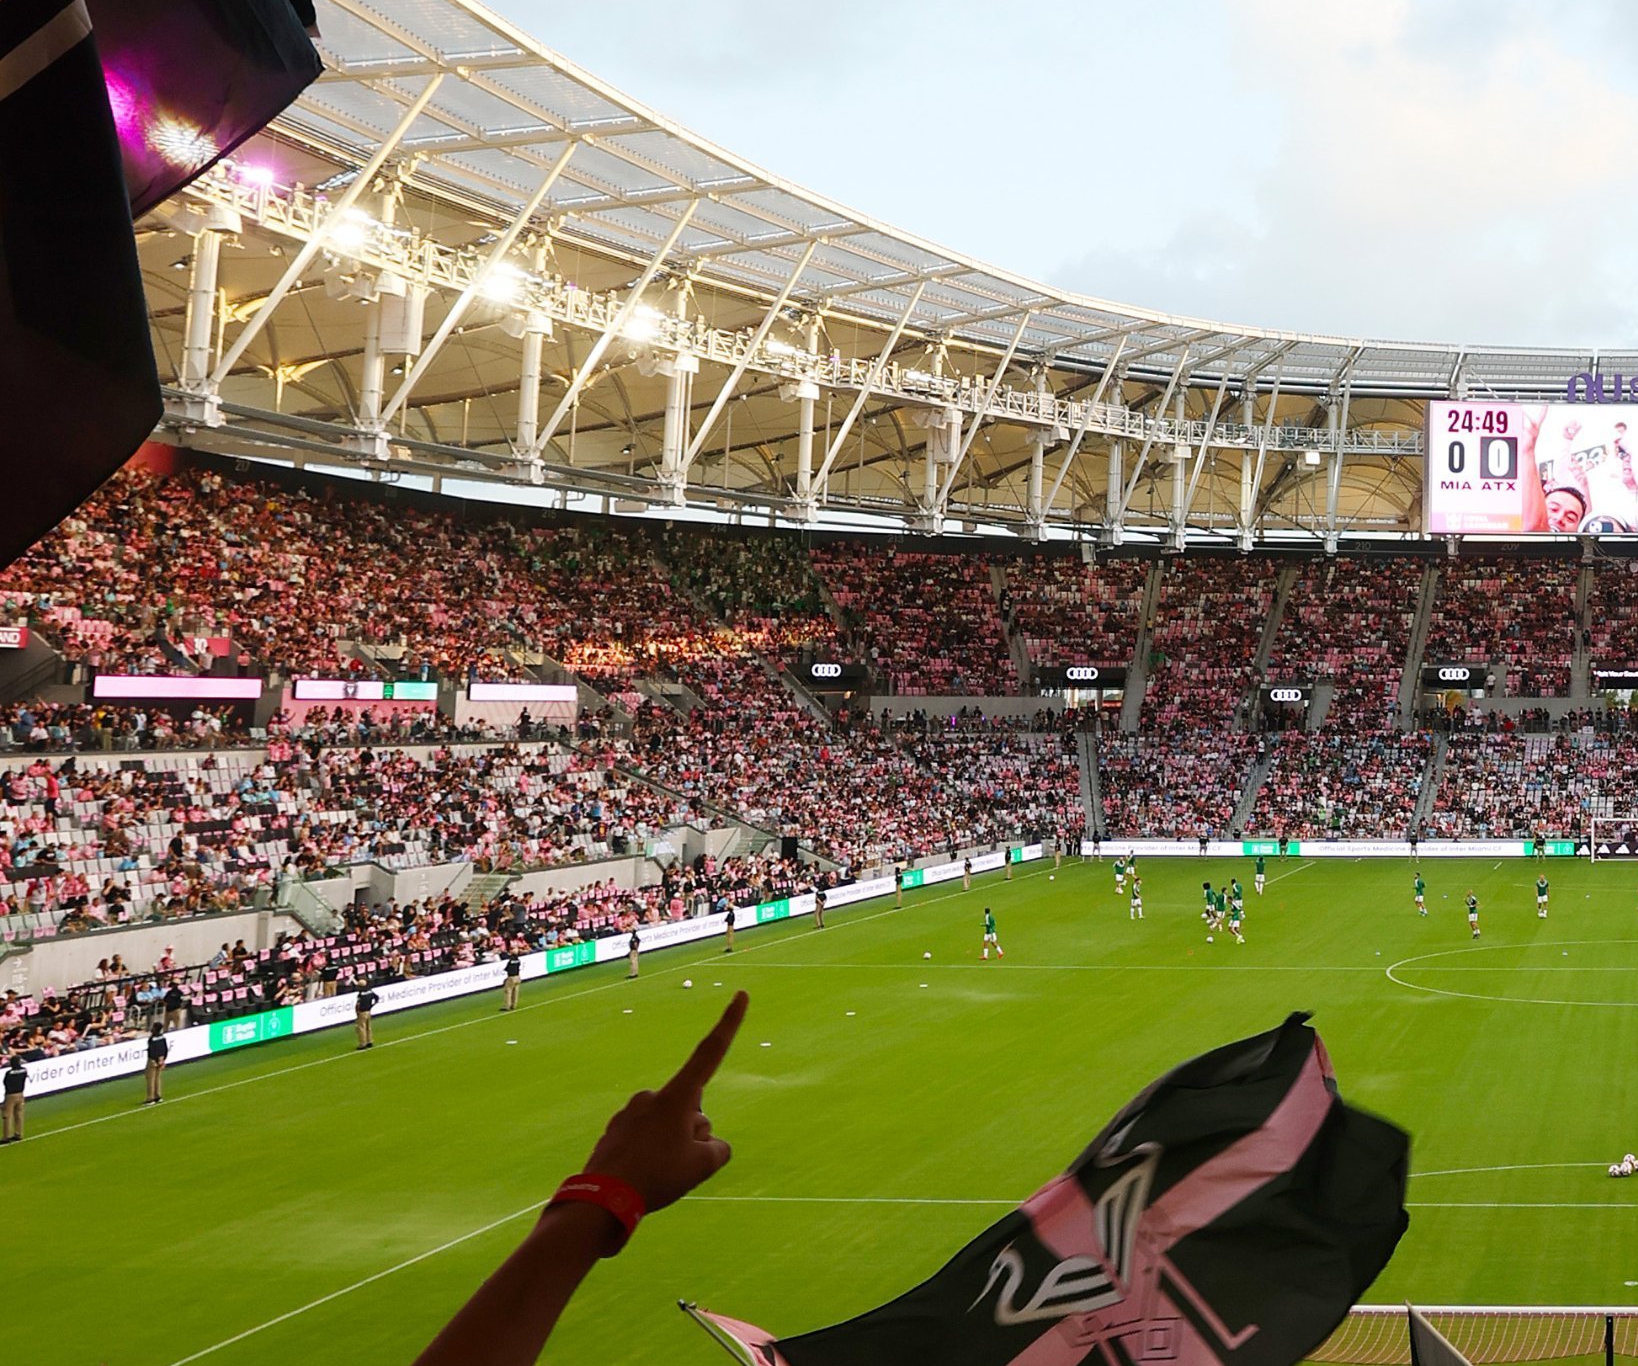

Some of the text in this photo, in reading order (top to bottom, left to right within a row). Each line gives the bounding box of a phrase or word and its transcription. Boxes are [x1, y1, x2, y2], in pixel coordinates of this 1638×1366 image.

[1447, 410, 1508, 434] 24:49
[1448, 440, 1465, 474] 0
[1488, 439, 1510, 477] 0
[1440, 481, 1472, 490] MIA
[1481, 481, 1516, 491] ATX
[320, 968, 506, 1017] Official Medicine Provider of Inter Mia
[28, 1039, 175, 1084] vider of Inter Mia F
